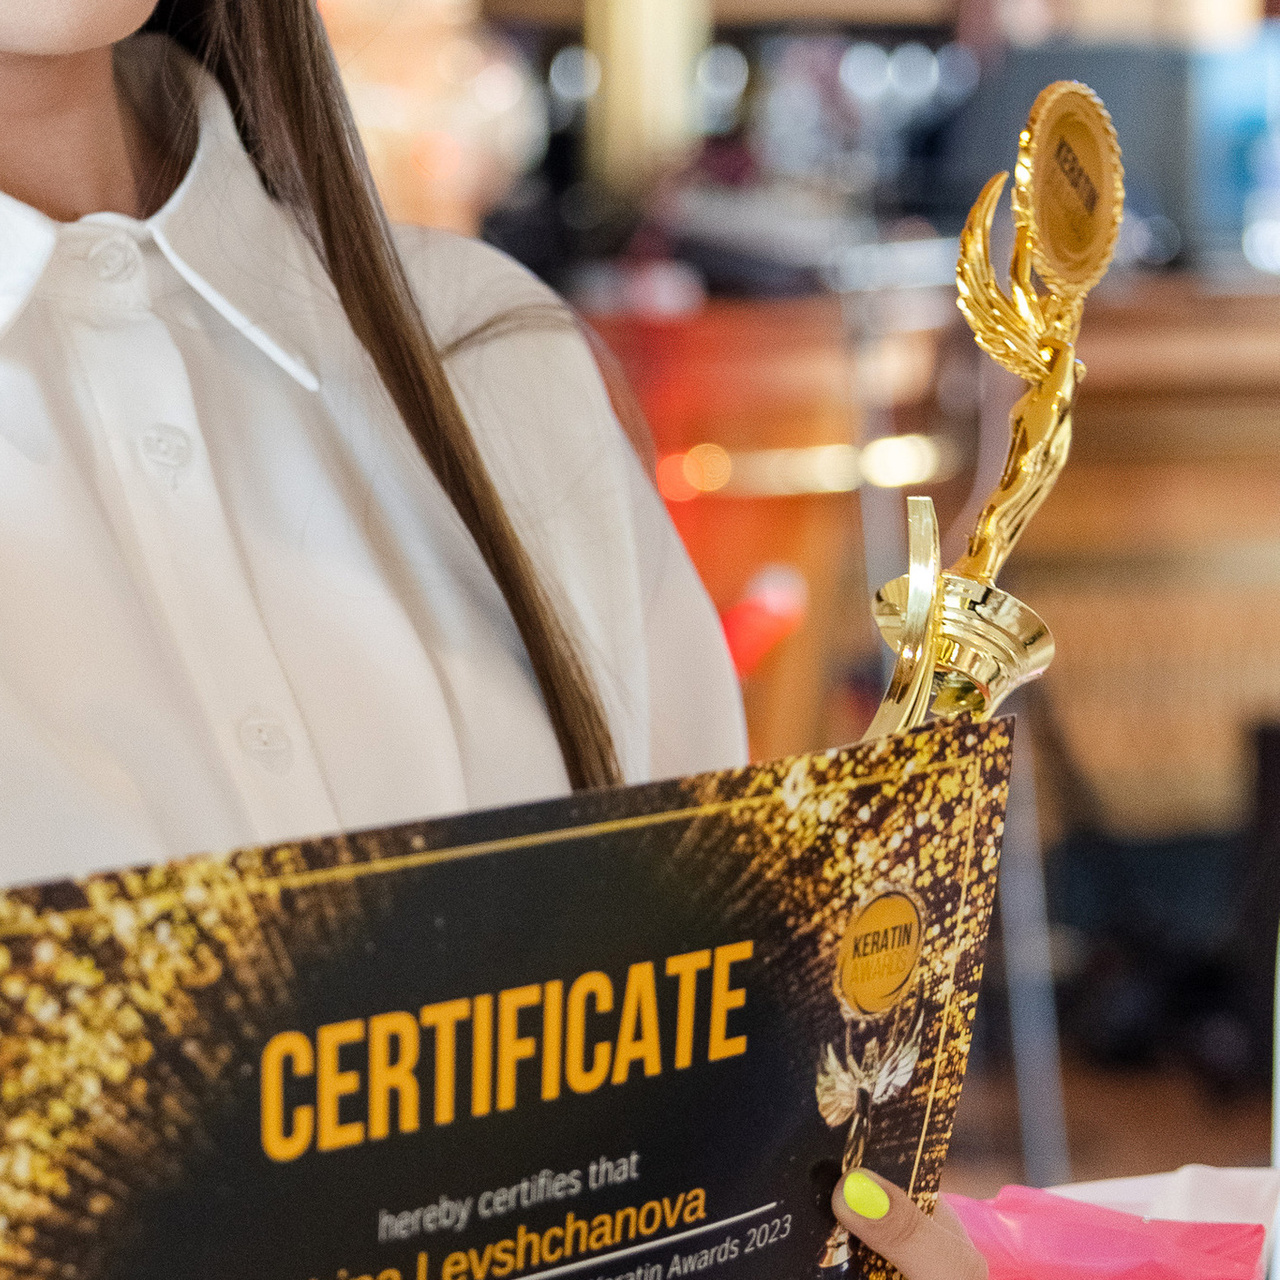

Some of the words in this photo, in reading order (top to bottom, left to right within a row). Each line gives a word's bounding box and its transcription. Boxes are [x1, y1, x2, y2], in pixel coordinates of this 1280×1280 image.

[853, 921, 913, 959] KERATIN
[261, 940, 754, 1162] CERTIFICATE
[378, 1194, 472, 1242] hereby
[478, 1169, 582, 1218] certifies
[588, 1150, 640, 1190] that
[666, 1236, 739, 1280] Awards
[743, 1214, 792, 1254] 2023
